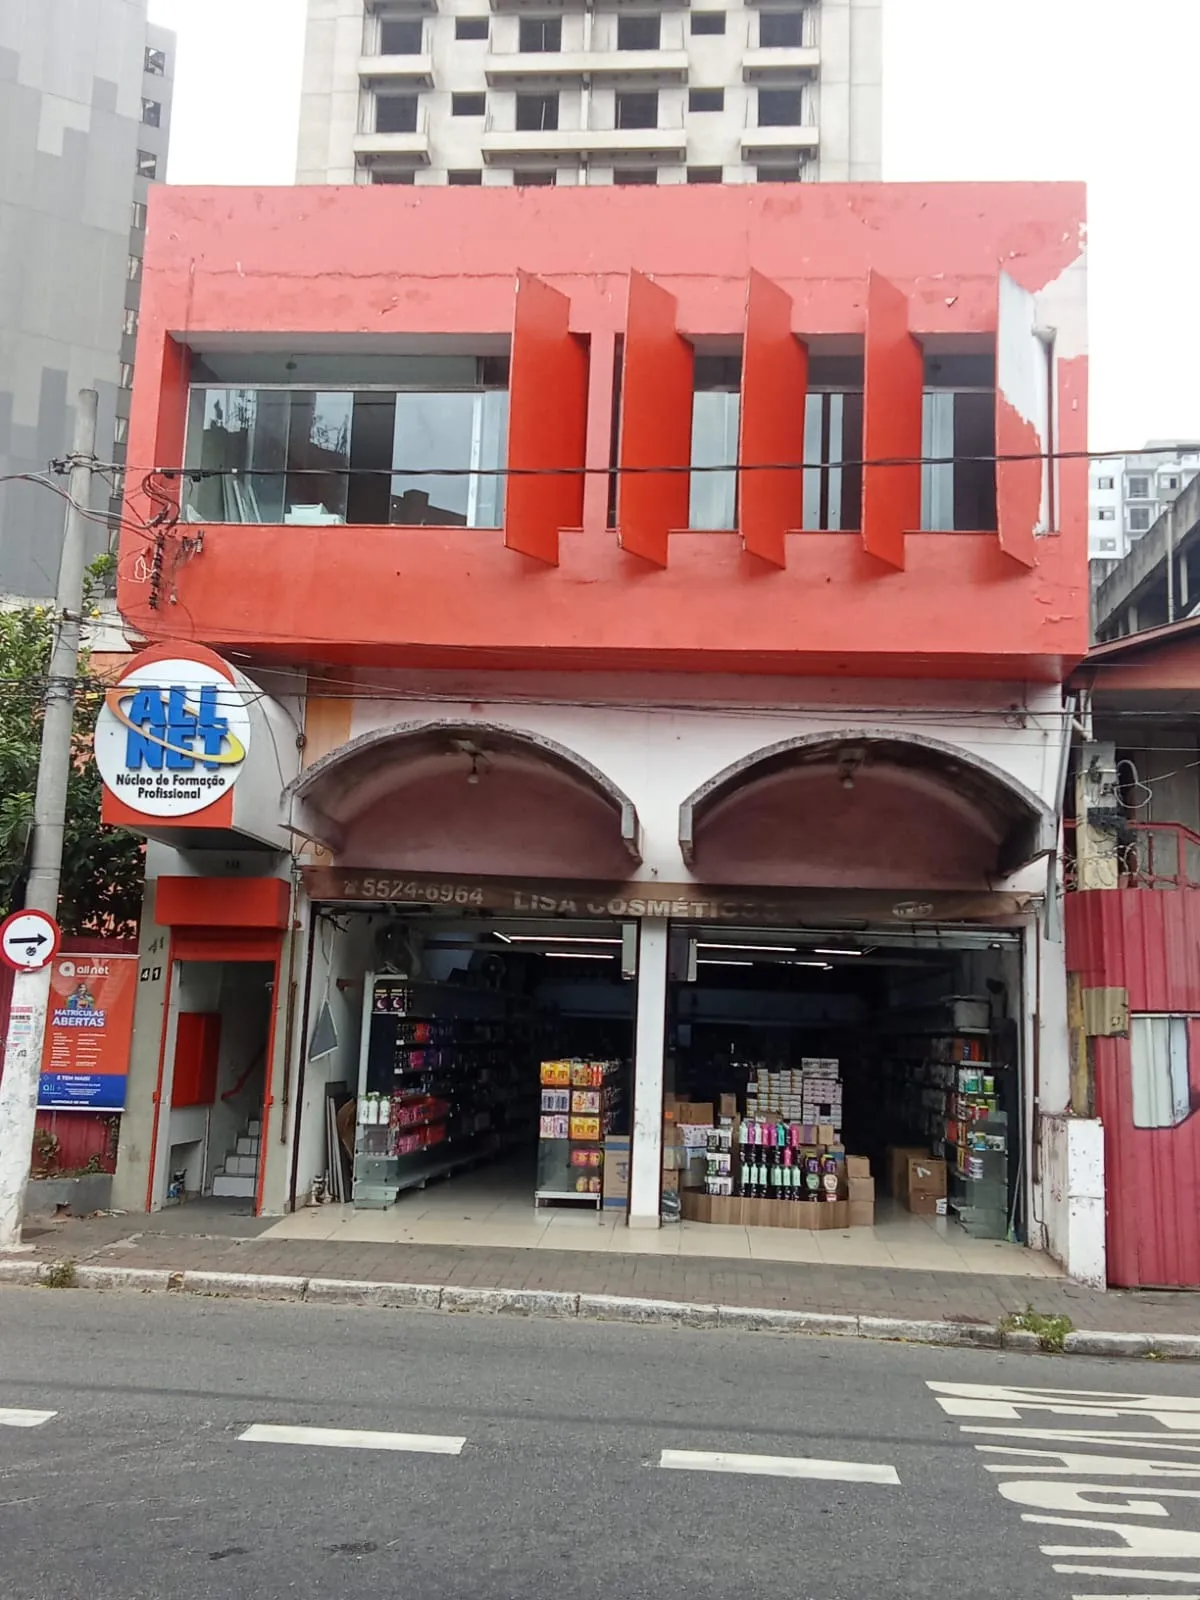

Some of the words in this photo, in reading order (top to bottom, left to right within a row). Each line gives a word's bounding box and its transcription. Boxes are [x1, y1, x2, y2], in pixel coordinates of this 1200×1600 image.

[128, 685, 228, 727] ALL
[126, 726, 229, 771] NET
[116, 774, 152, 786] Núcleo
[155, 775, 169, 786] de
[172, 775, 226, 788] Formação
[137, 787, 201, 799] Profissional
[362, 878, 484, 905] 5524-6964
[141, 965, 159, 978] 41
[52, 1017, 105, 1027] ABERTAS
